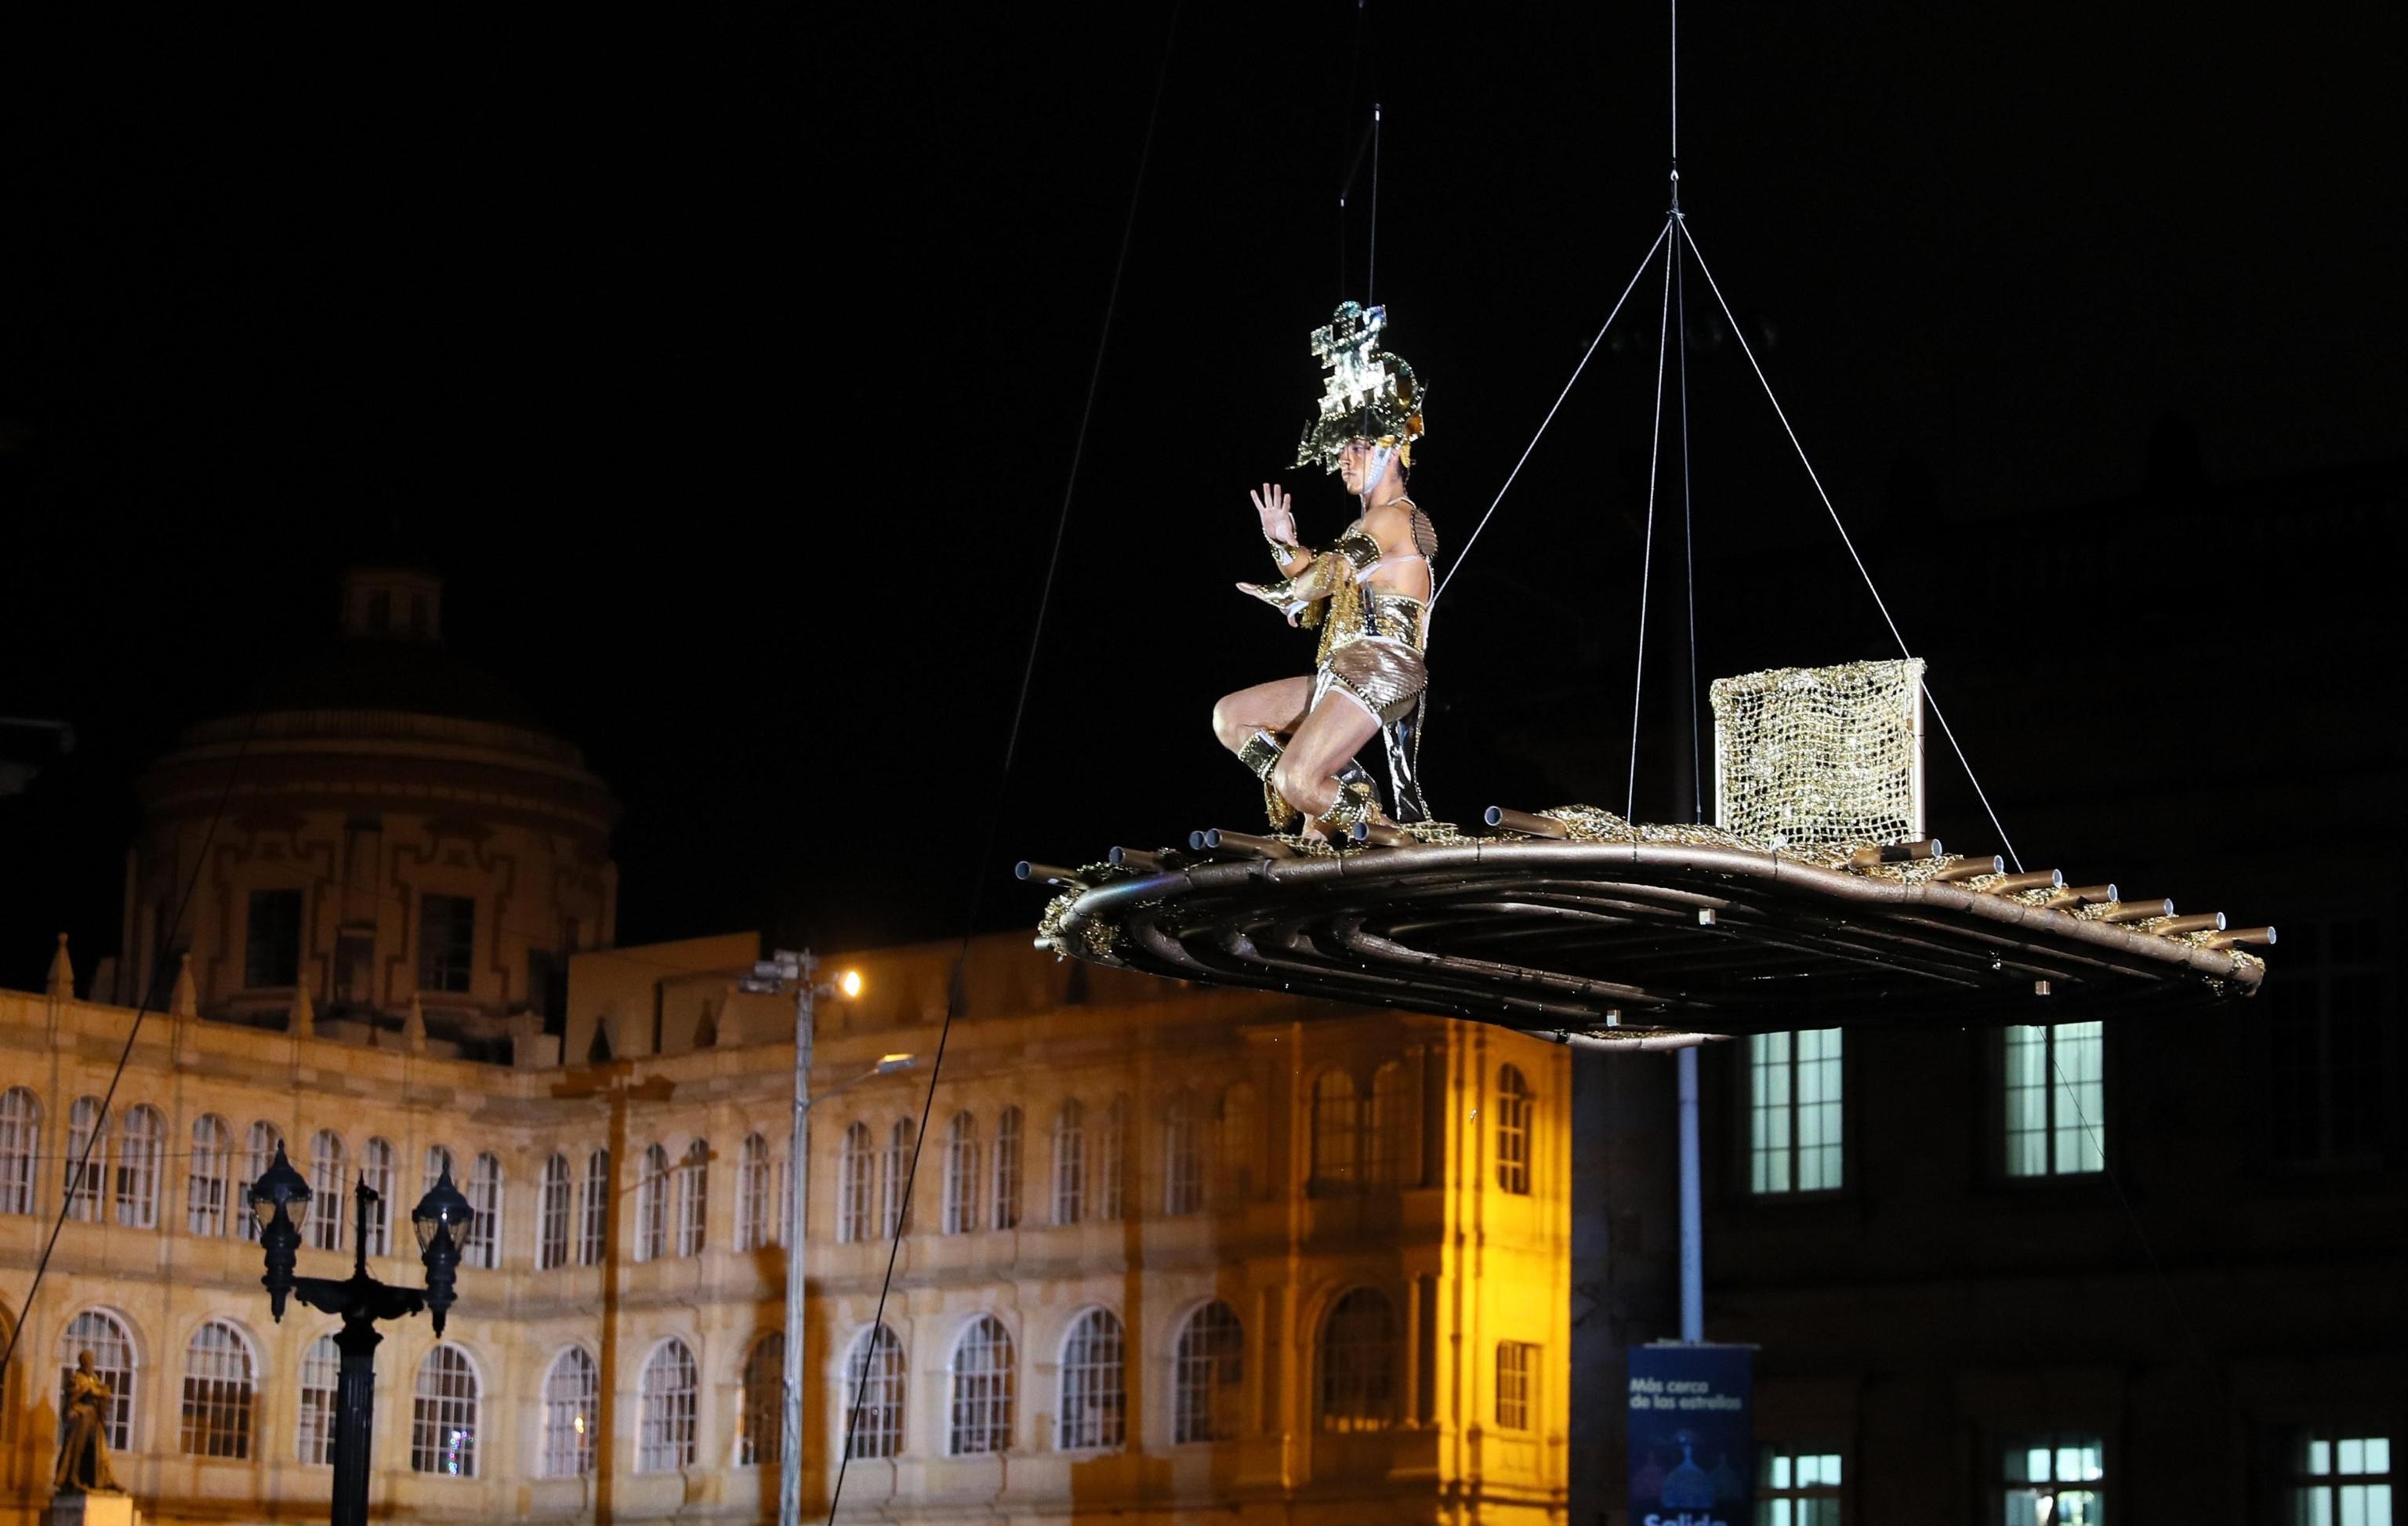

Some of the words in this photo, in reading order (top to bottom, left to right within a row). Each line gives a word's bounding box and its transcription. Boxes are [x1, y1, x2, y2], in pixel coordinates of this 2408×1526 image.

[1630, 1377, 1663, 1394] Más
[1666, 1381, 1709, 1394] cerca
[1630, 1394, 1650, 1408] de
[1653, 1394, 1676, 1408] las
[1679, 1394, 1741, 1409] estrellas
